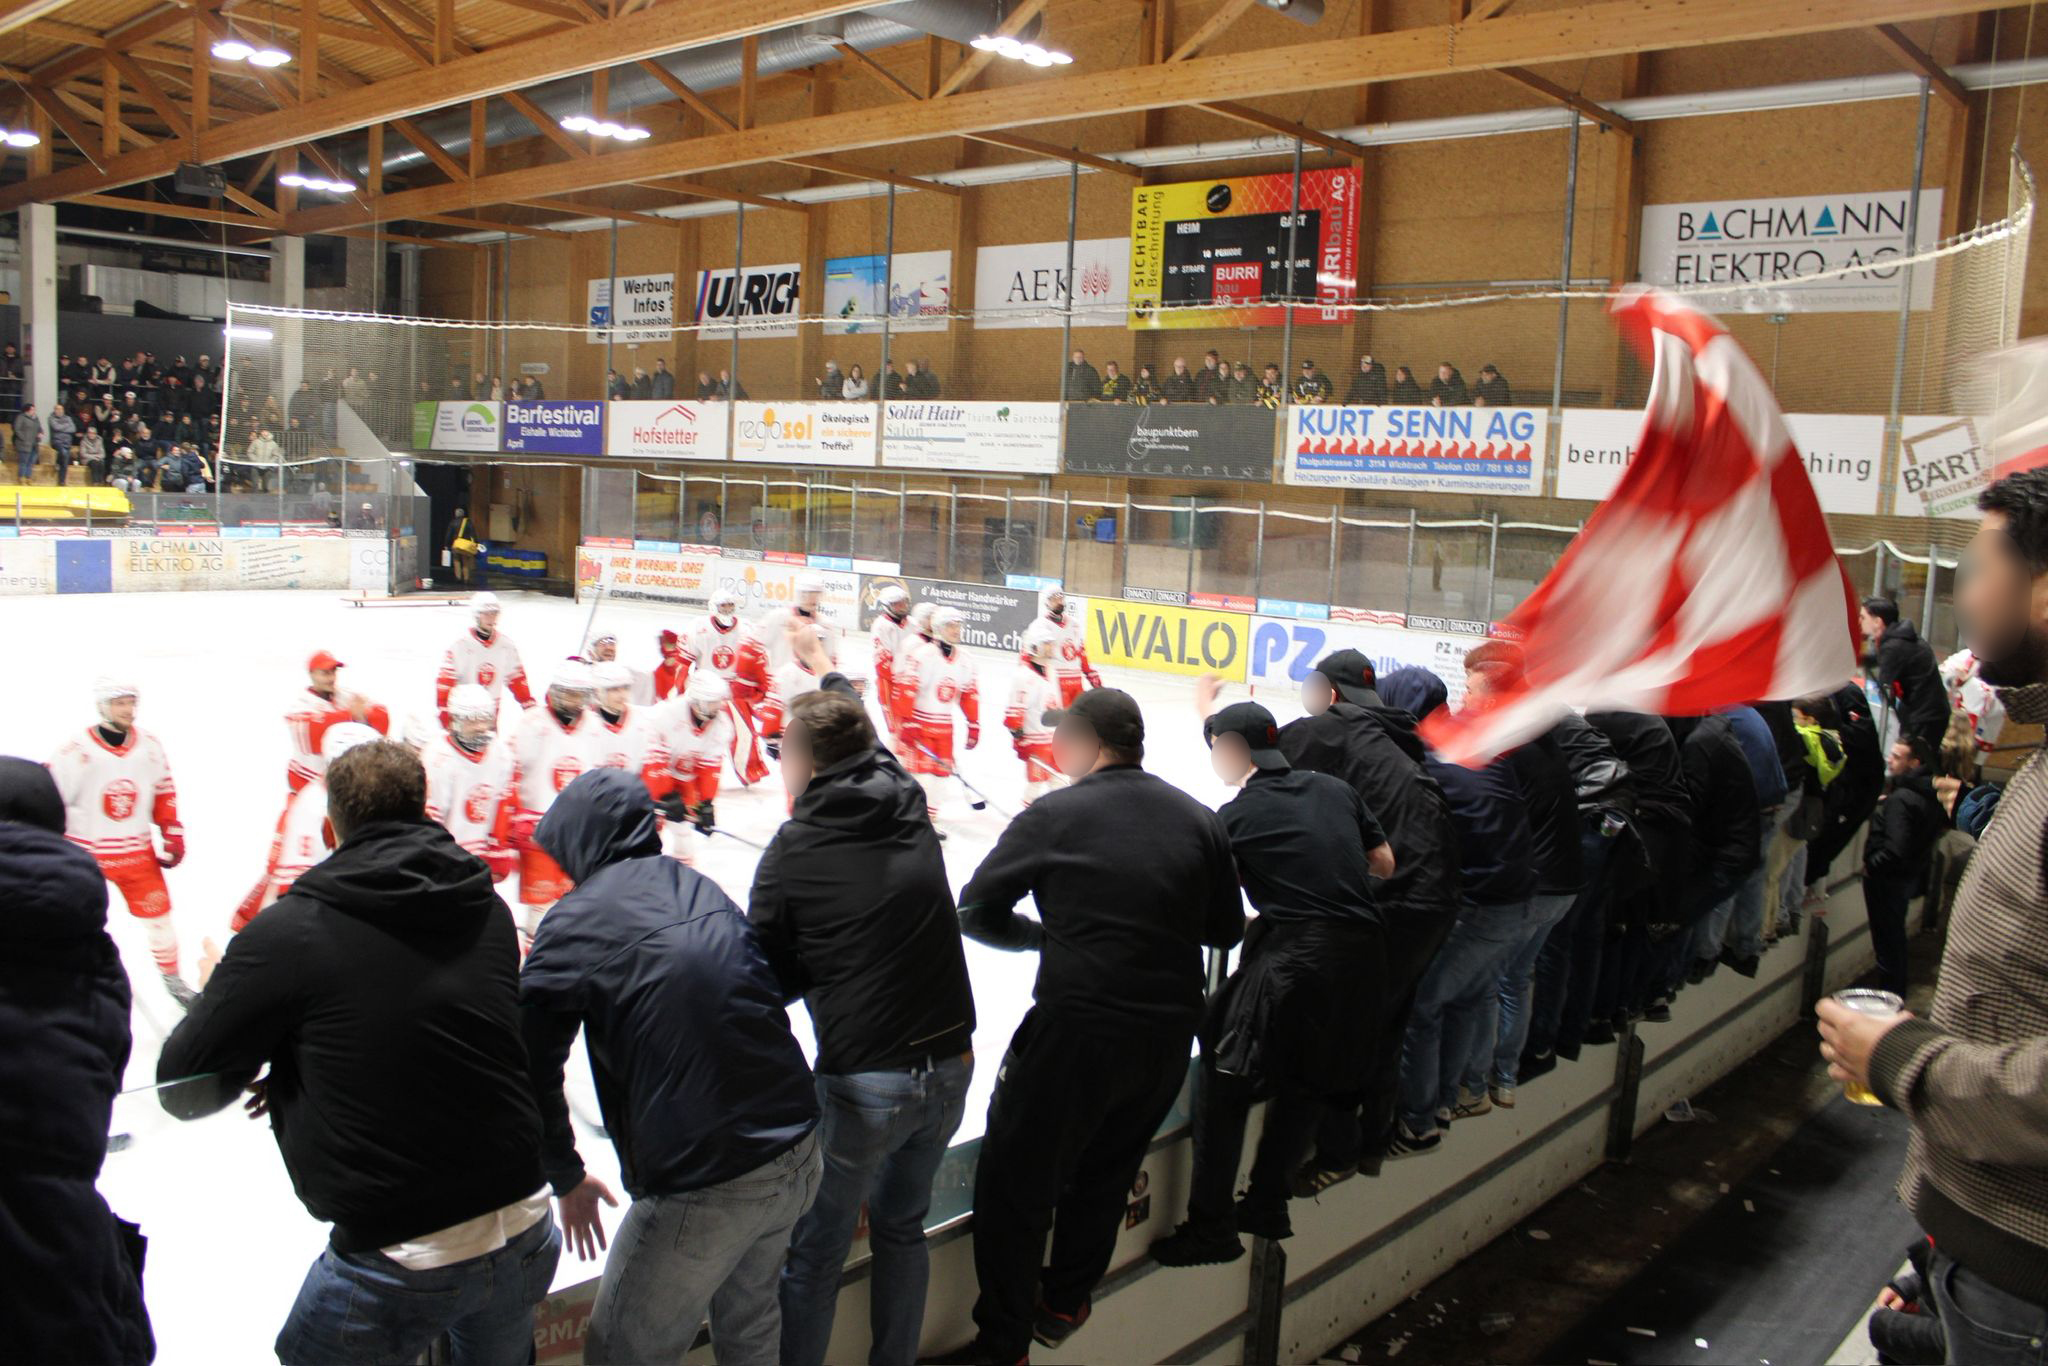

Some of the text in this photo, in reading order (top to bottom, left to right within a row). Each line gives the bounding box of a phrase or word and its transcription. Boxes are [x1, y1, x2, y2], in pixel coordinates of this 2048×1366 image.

[1331, 175, 1345, 202] AG
[1176, 222, 1201, 234] HEIM
[1280, 215, 1307, 228] GAT
[1677, 200, 1906, 241] BACHMANN
[1134, 193, 1148, 287] SICHTBAR
[1215, 265, 1259, 280] BURRI
[1675, 249, 1825, 284] ELEKTRO
[623, 278, 674, 294] Werbun
[1007, 268, 1076, 303] AEK
[1216, 282, 1239, 293] bau
[633, 298, 665, 313] Infos
[507, 404, 600, 425] Barfestival
[821, 412, 870, 425] Ökologisch
[887, 404, 965, 420] Solid Hair
[1298, 408, 1536, 441] KURT SENN AG
[507, 438, 524, 449] April
[633, 426, 698, 445] Hofstetter
[821, 441, 854, 451] Treffer!
[1568, 443, 1637, 466] bernh
[1800, 452, 1871, 481] hing
[1902, 446, 1982, 493] BÄRT
[1294, 471, 1531, 493] Heizungen Sanitäre Anlagen Kaminsanierungen
[130, 541, 224, 554] BACHMANN
[130, 556, 223, 572] ELEKTRO AG
[610, 557, 705, 574] IHRE WERBUNG SORGT
[0, 576, 49, 588] nergy
[614, 570, 633, 584] FÜR
[1410, 617, 1482, 634] DINACO DINACO
[961, 624, 1022, 651] time.ch
[1096, 608, 1237, 669] WALO
[1252, 621, 1326, 682] PZ
[1435, 641, 1451, 654] PZ
